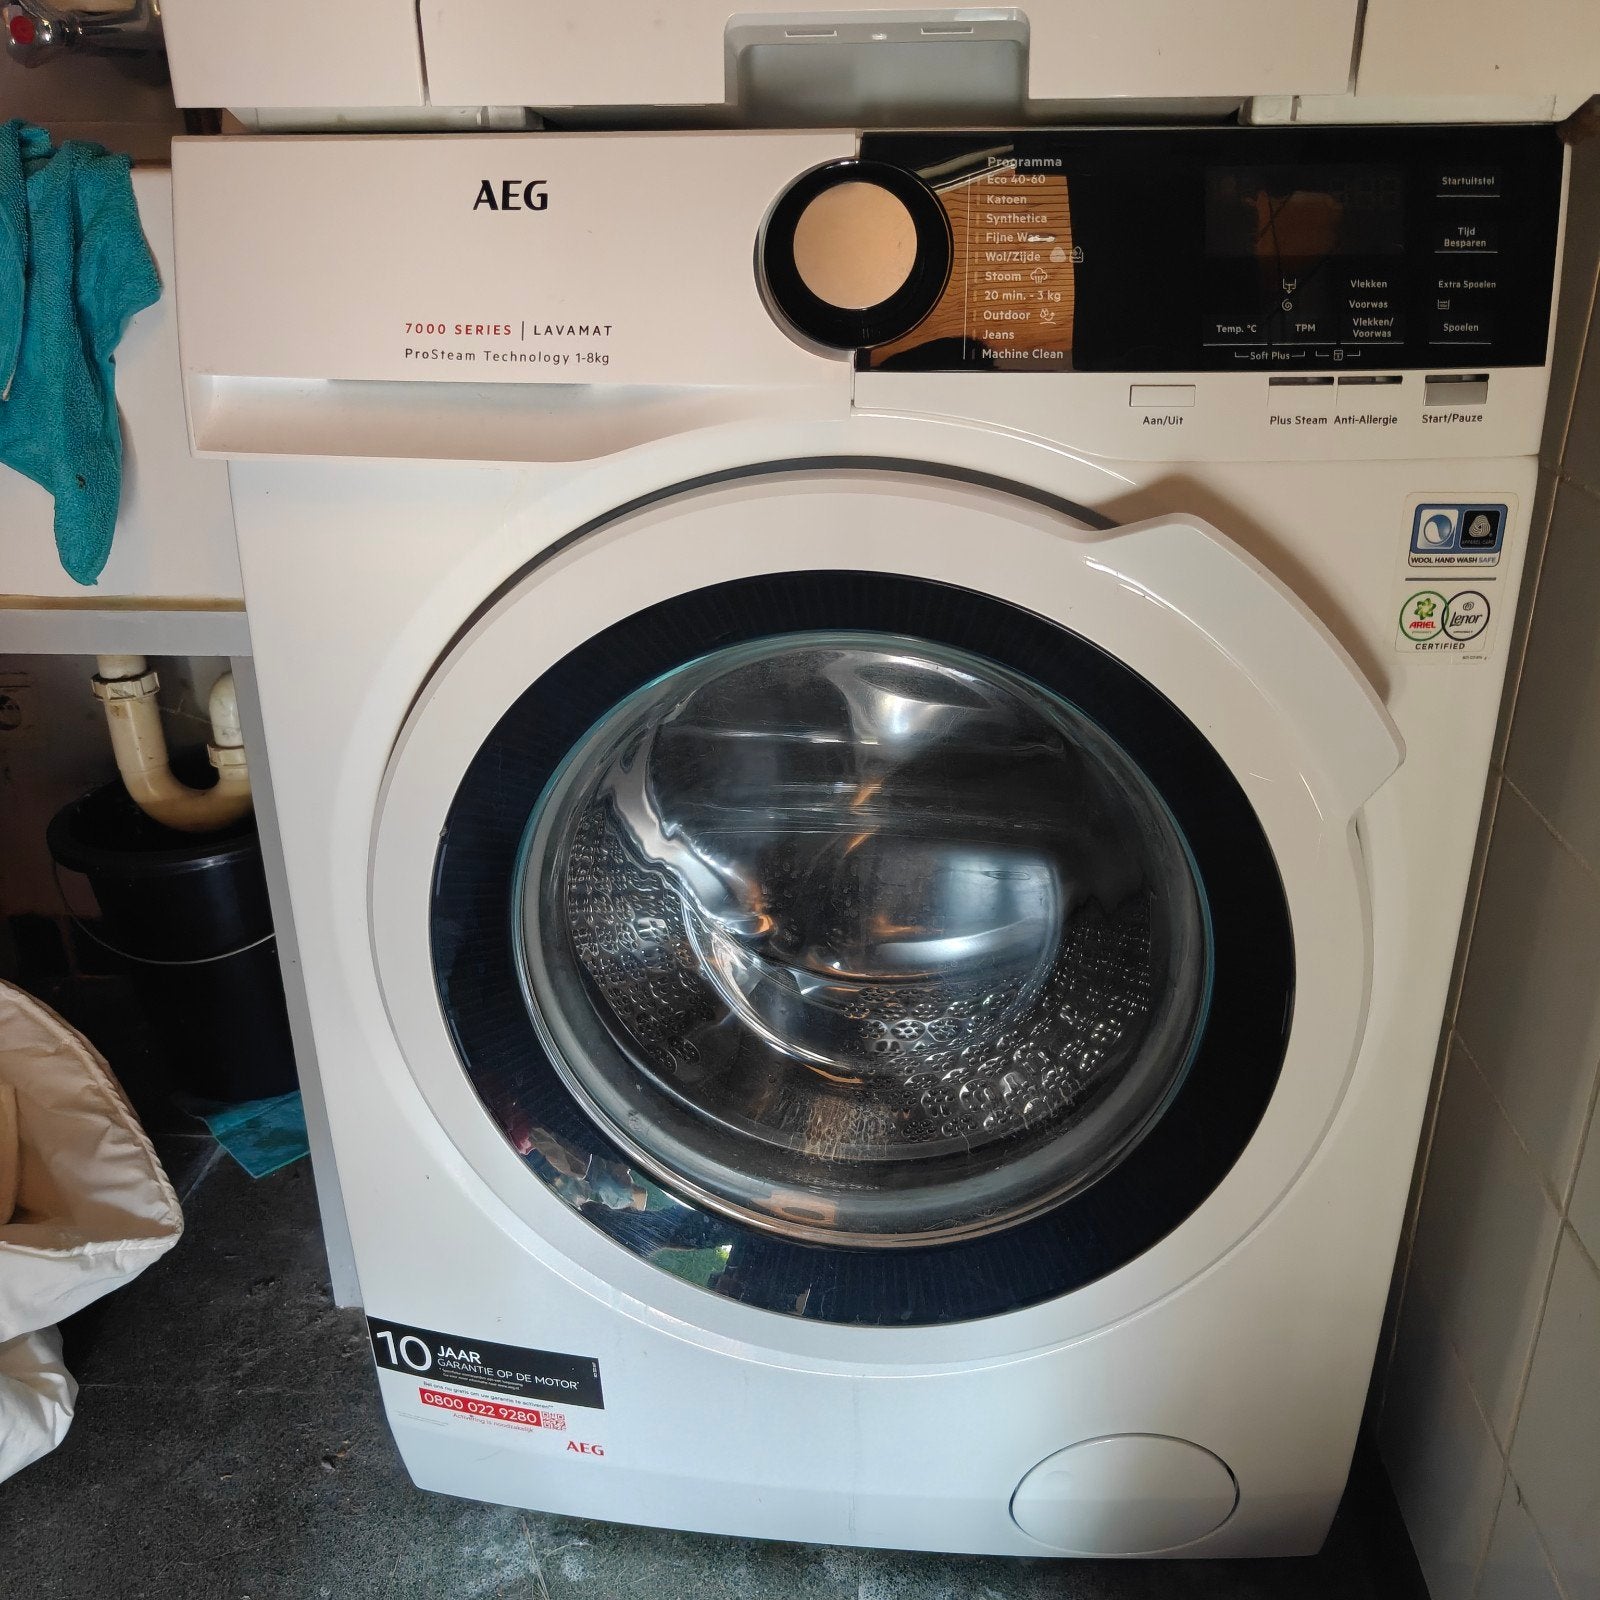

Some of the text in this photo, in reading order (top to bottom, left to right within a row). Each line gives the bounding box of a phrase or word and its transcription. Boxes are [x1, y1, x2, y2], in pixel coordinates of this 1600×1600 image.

[987, 156, 1062, 168] Programma
[987, 174, 1046, 184] Eco 40-60
[1442, 176, 1494, 186] Startuitstel
[473, 180, 548, 210] AEG
[986, 194, 1027, 204] Katoen
[986, 214, 1048, 226] Synthetica
[1458, 226, 1476, 238] Tijd
[986, 232, 1014, 244] Fijne
[1444, 238, 1486, 248] Besparen
[985, 251, 1041, 264] Wol/Zijde
[985, 271, 1022, 282] Stoom
[1350, 279, 1388, 288] Vlekken
[1438, 280, 1496, 290] Extra Spoelen
[984, 290, 998, 300] 20
[1002, 290, 1026, 300] min.
[1037, 290, 1044, 300] 3
[1048, 290, 1061, 302] kg
[1349, 300, 1388, 309] Voorwas
[984, 310, 1030, 320] Outdoor
[1295, 323, 1316, 332] TPM
[1352, 316, 1394, 328] Vlekken/
[1444, 322, 1479, 332] Spoelen
[405, 323, 613, 337] 7000 SERIES LAVAMAT
[982, 329, 1014, 340] Jeans
[1216, 324, 1257, 334] Temp. °C
[1352, 329, 1392, 338] Voorwas
[405, 348, 610, 366] ProSteam Technology 1-8kg
[982, 348, 1064, 360] Machine Clean
[1250, 351, 1290, 360] Soft Plus
[1142, 415, 1184, 426] Aan/Uit
[1270, 415, 1328, 426] Plus Steam
[1334, 414, 1398, 428] Anti-Allergie
[1422, 414, 1483, 425] Start/Pauze
[1409, 621, 1436, 629] ARIEL
[1449, 612, 1482, 628] Lenor
[1415, 642, 1466, 650] CERTIFIED
[376, 1330, 482, 1371] 10 JAAR
[438, 1358, 494, 1376] GARANTIE
[496, 1369, 513, 1379] OP
[516, 1372, 532, 1383] DE
[424, 1392, 536, 1423] 0800 022 9280
[566, 1440, 604, 1456] AEG
